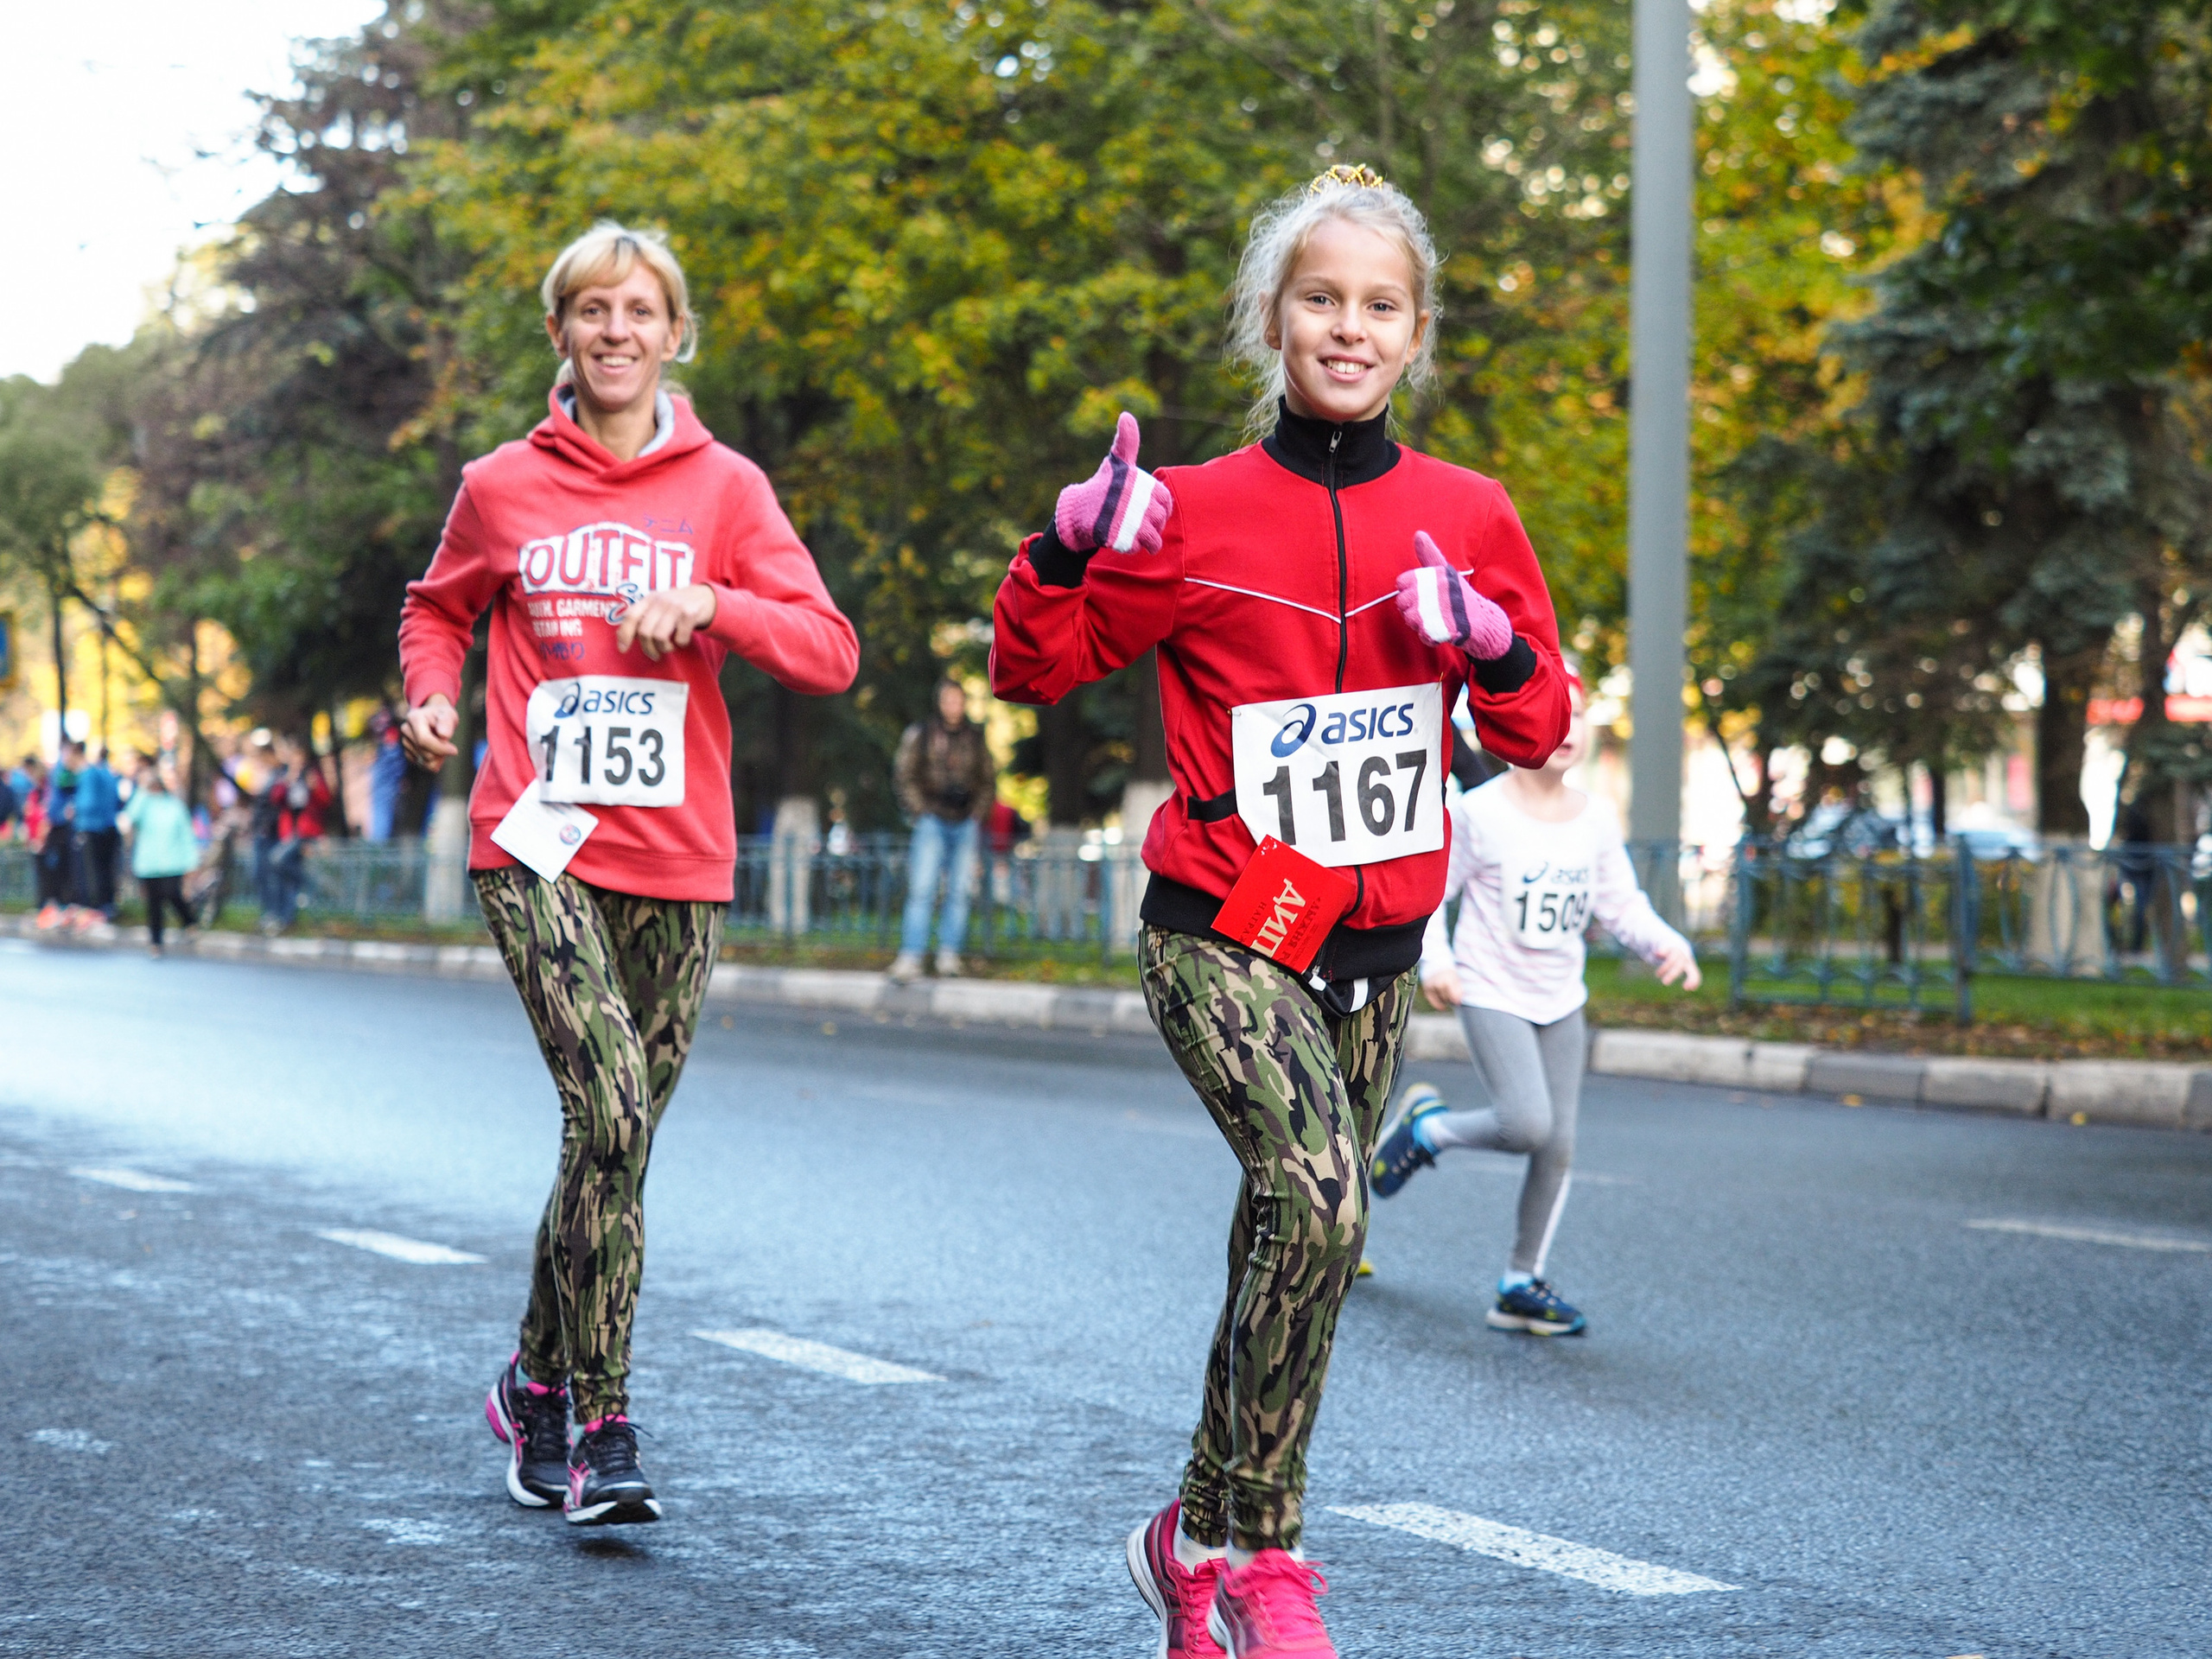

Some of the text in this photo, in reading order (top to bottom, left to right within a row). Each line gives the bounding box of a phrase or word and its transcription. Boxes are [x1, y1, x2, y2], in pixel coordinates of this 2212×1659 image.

[524, 529, 687, 589] OUTFIT
[539, 725, 665, 787] 1153
[1262, 748, 1427, 846] 1167
